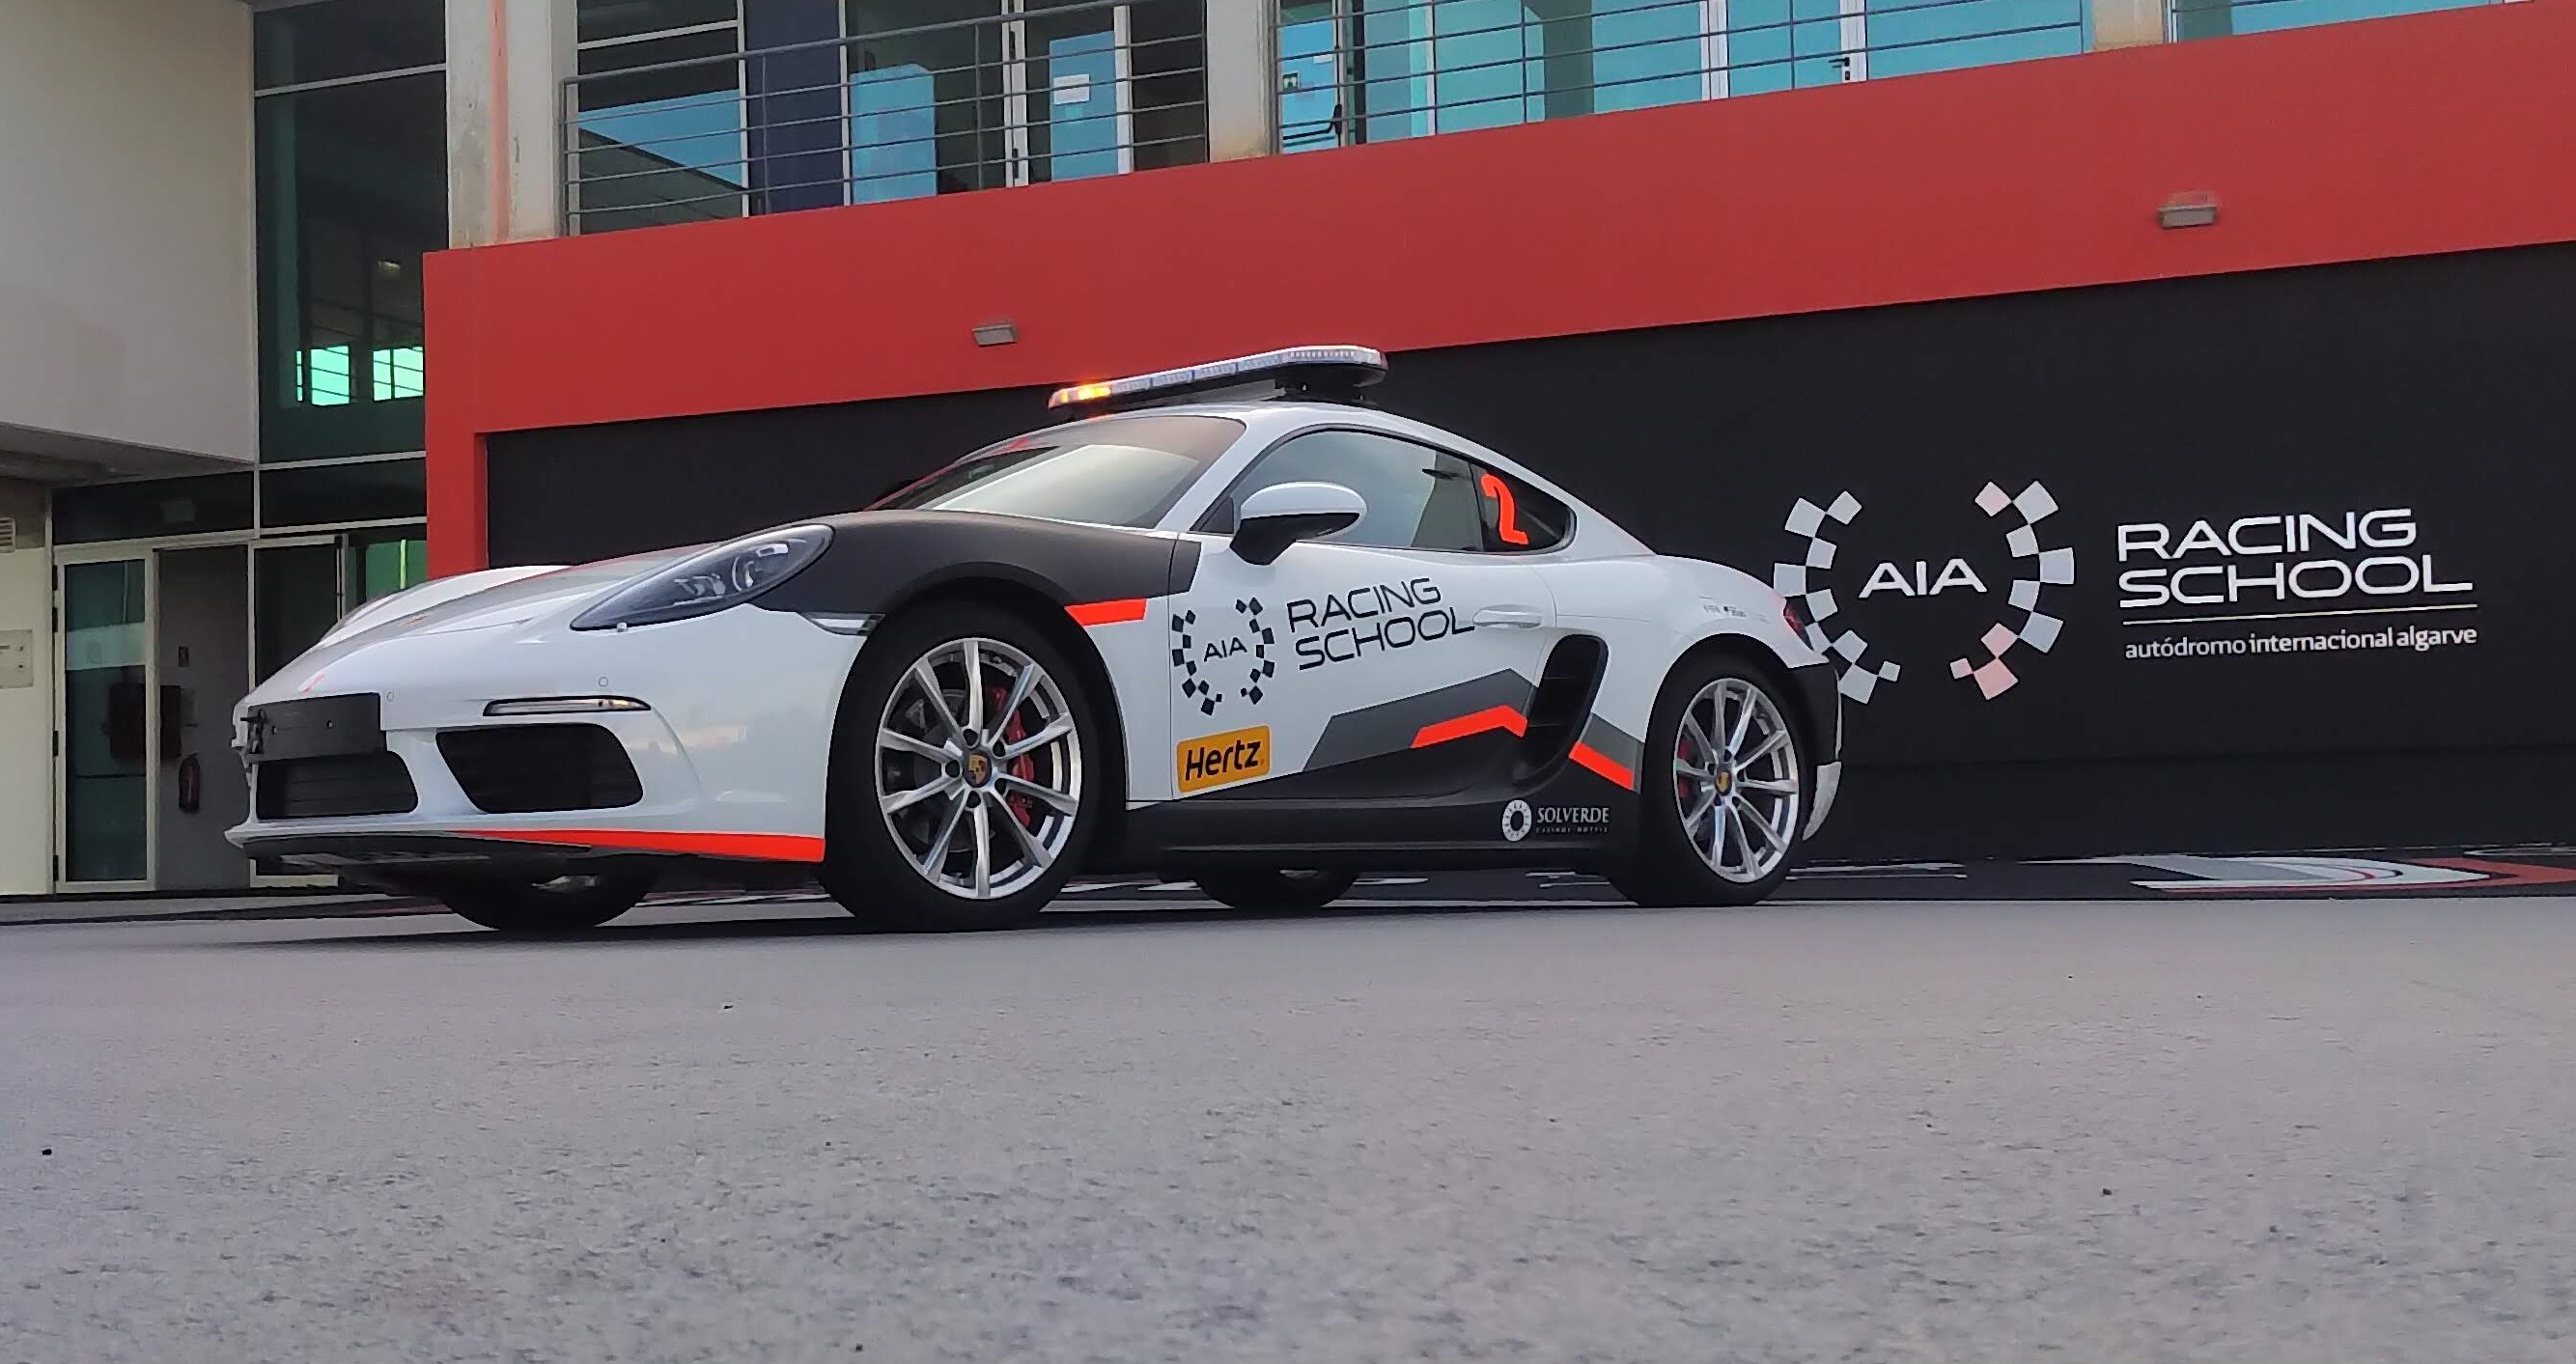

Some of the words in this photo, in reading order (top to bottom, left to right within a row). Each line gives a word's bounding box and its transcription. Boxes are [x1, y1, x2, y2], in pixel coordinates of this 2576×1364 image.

[1480, 473, 1528, 544] 2
[2117, 508, 2417, 562] RACING
[1858, 558, 1987, 598] AIA
[2118, 554, 2474, 608] SCHOOL
[1286, 577, 1442, 633] RACING
[1203, 636, 1247, 663] AIA
[1295, 606, 1475, 671] SCHOOL
[2125, 636, 2247, 659] autódromo
[2249, 627, 2394, 654] internacional
[2395, 626, 2478, 652] algarve
[1185, 739, 1261, 781] Hertz
[1536, 807, 1610, 823] SOLVERDE
